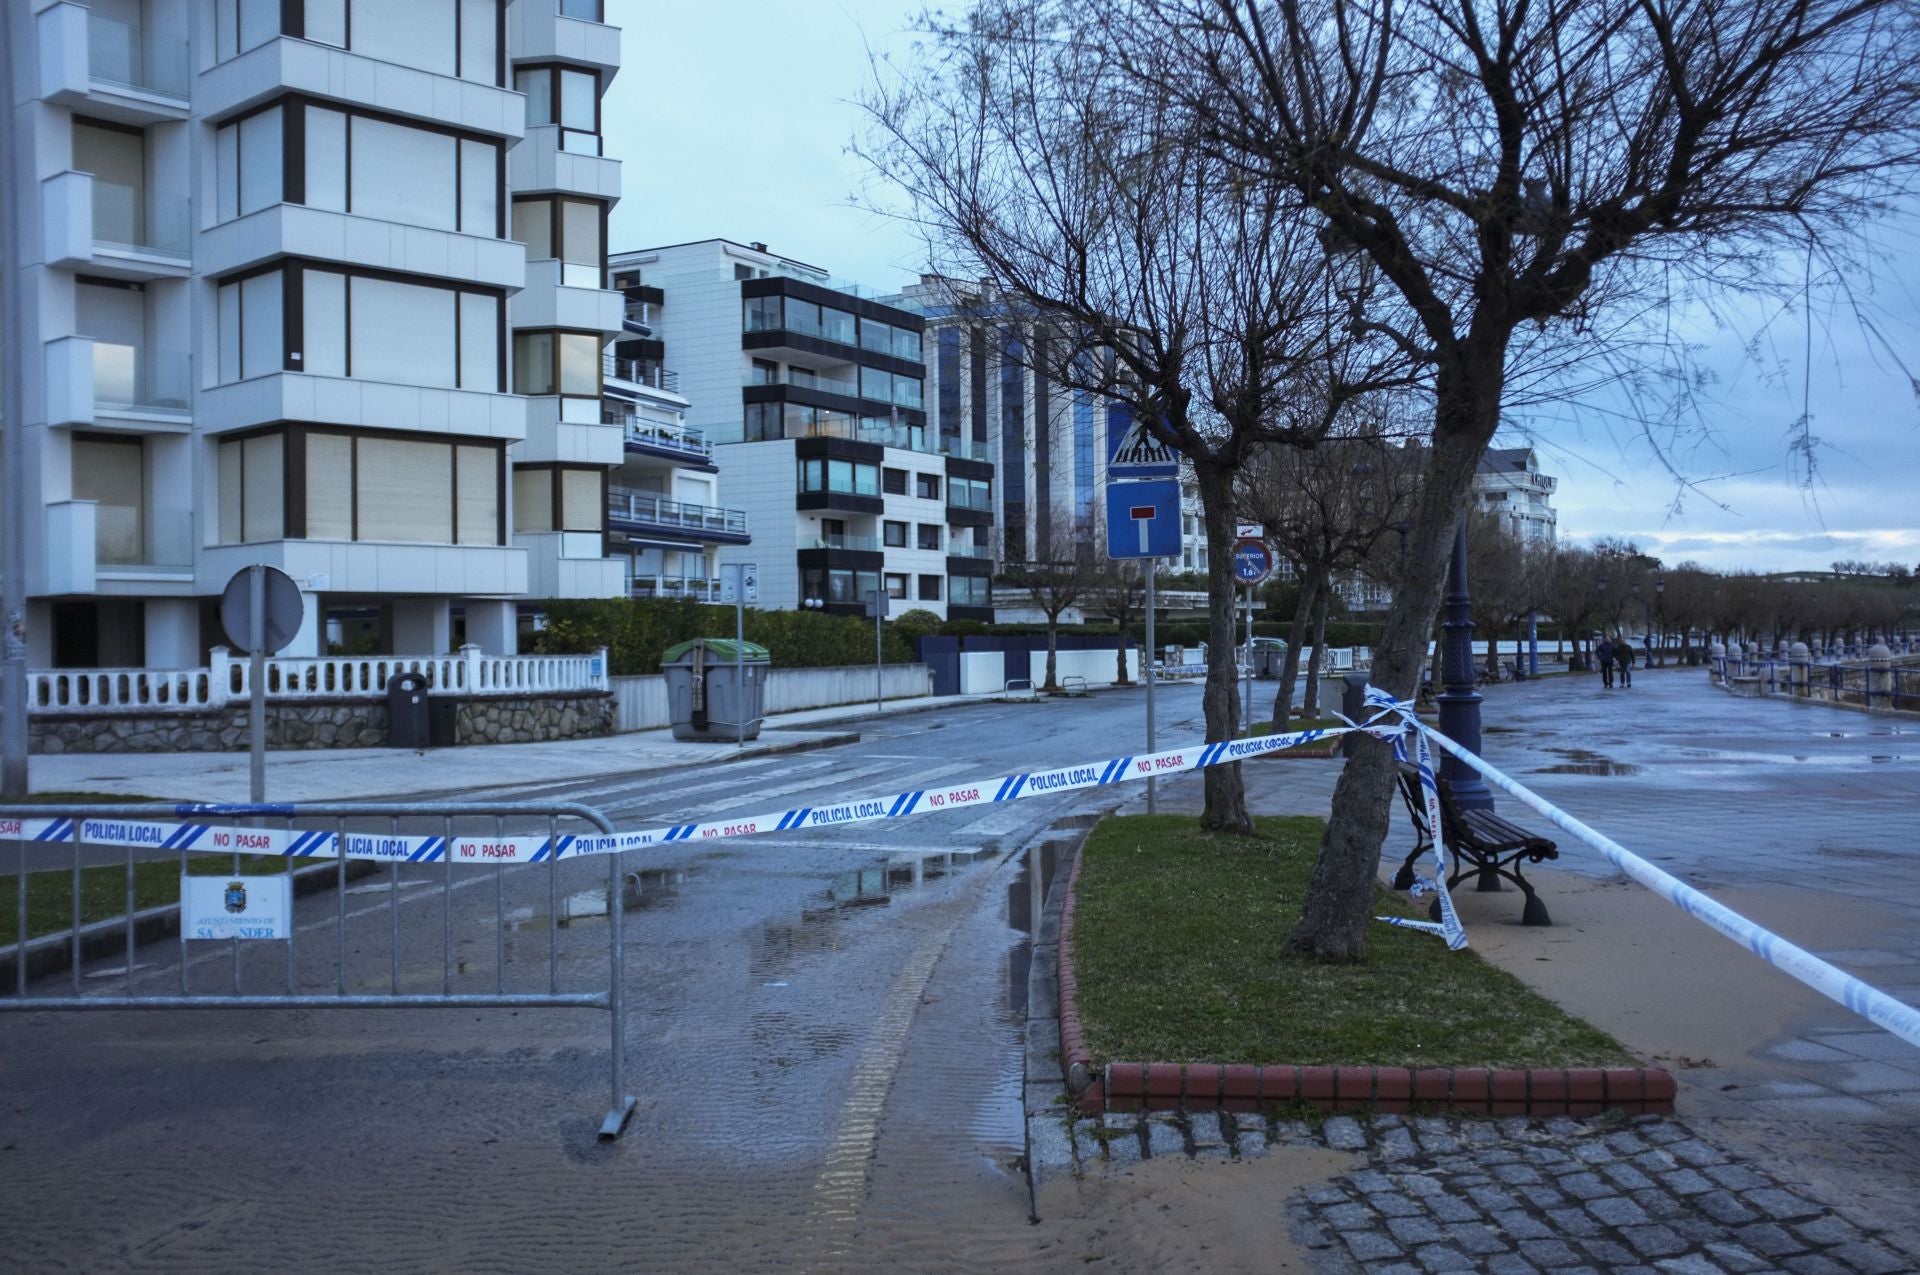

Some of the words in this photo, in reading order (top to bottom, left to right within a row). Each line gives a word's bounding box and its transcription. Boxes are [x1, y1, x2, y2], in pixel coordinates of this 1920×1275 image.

[1230, 741, 1264, 756] POLICIA
[1265, 736, 1292, 750] LOCAL
[1137, 760, 1152, 773] NO
[1155, 755, 1184, 769] PASAR
[1029, 775, 1068, 791] POLICIA
[1069, 768, 1099, 784] LOCAL
[929, 794, 945, 807] NO
[949, 789, 981, 804] PASAR
[811, 808, 852, 824] POLICIA
[854, 801, 887, 818] LOCAL
[84, 822, 126, 841] POLICIA
[128, 825, 163, 843] LOCAL
[724, 823, 756, 836] PASAR
[213, 833, 230, 847] NO
[235, 834, 270, 848] PASAR
[331, 836, 373, 855] PLICIA
[376, 839, 409, 856] LOCAL
[460, 844, 476, 858] NO
[482, 844, 516, 858] PASAR
[197, 927, 274, 939] SANDER
